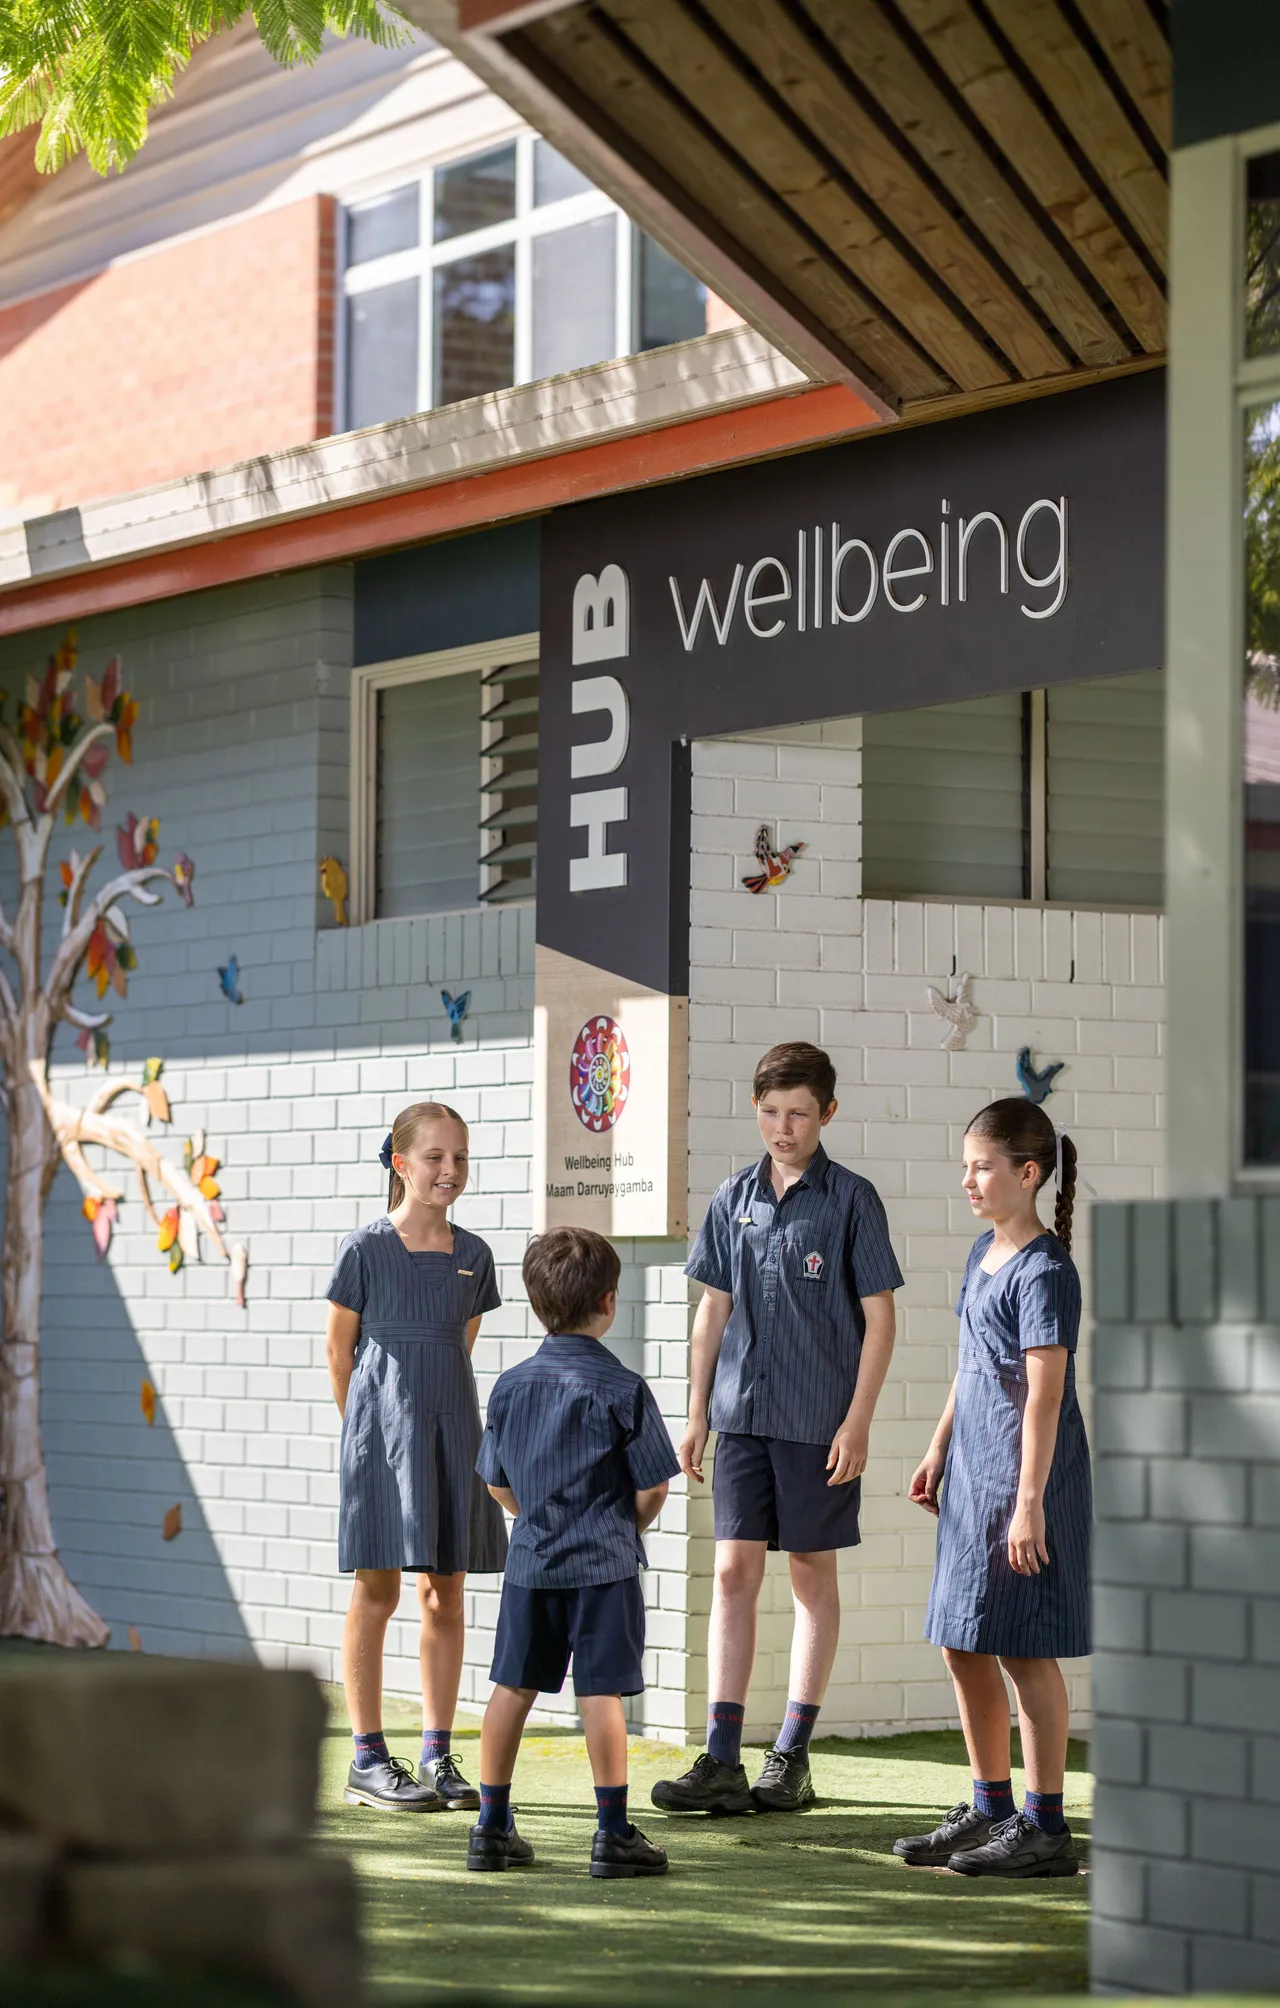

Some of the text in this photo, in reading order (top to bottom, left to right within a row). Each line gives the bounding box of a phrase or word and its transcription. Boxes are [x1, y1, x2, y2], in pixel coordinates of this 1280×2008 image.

[668, 495, 1069, 652] wellbeing
[570, 563, 630, 893] HUB
[546, 1178, 654, 1199] Maam Darruyaygamba
[564, 1152, 634, 1172] Wellbeing Hub
